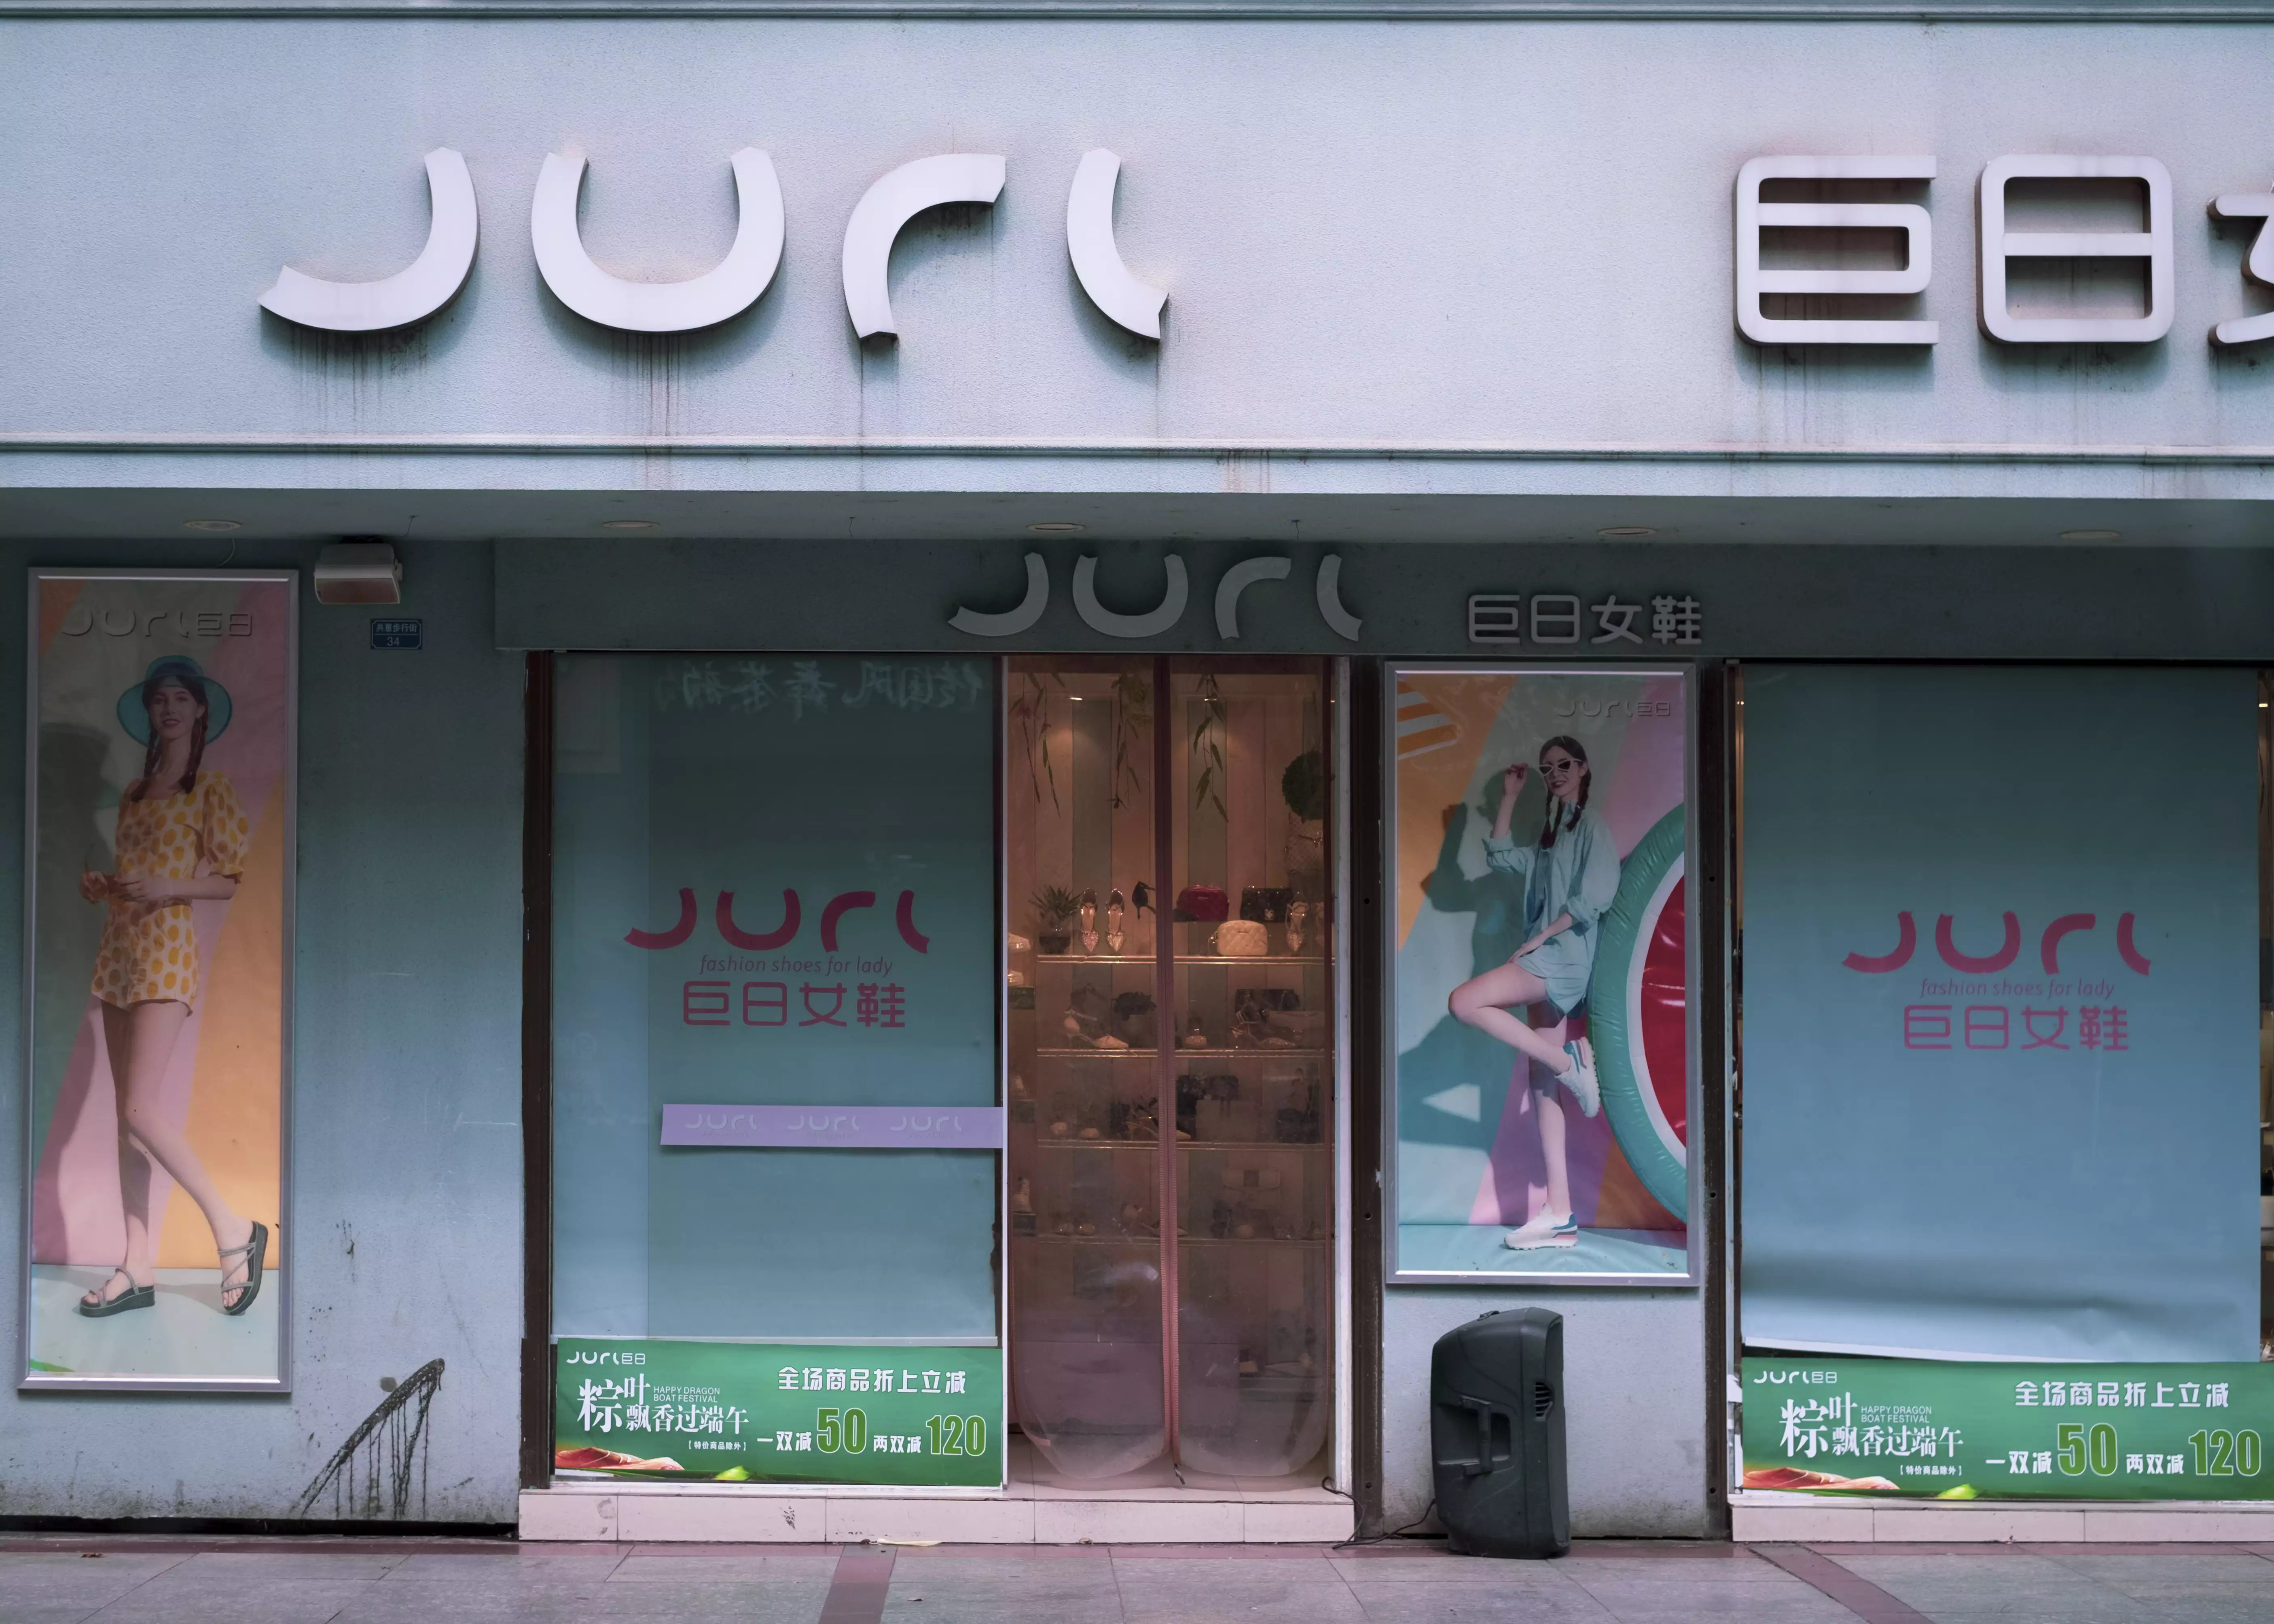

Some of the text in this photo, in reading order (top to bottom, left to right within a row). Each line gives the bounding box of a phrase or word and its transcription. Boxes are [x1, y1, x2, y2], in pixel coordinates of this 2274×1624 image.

[197, 612, 253, 637] 巨日
[1468, 594, 1702, 645] 巨日女鞋
[387, 636, 400, 646] 34
[1637, 701, 1671, 717] 巨日
[699, 954, 893, 978] fashion shoes for lady
[1919, 977, 2115, 1000] fashion shoes for lady
[683, 980, 905, 1028] 巨日女鞋
[1903, 1004, 2129, 1051] 巨日女鞋
[621, 1353, 646, 1365] 巨日
[778, 1366, 967, 1394] 全场商品折上立减
[1811, 1371, 1838, 1384] 巨日
[654, 1386, 720, 1395] HAPPY DRAGON
[654, 1394, 718, 1403] BOAT FESTIVAL
[2014, 1380, 2230, 1408] 全场商品折上立减
[1861, 1406, 1932, 1415] HAPPY DRAGON
[1861, 1415, 1930, 1423] BOAT FESTIVAL
[816, 1406, 867, 1455] 50
[925, 1415, 987, 1457] 120
[2057, 1422, 2119, 1477] 50
[2188, 1429, 2261, 1477] 120
